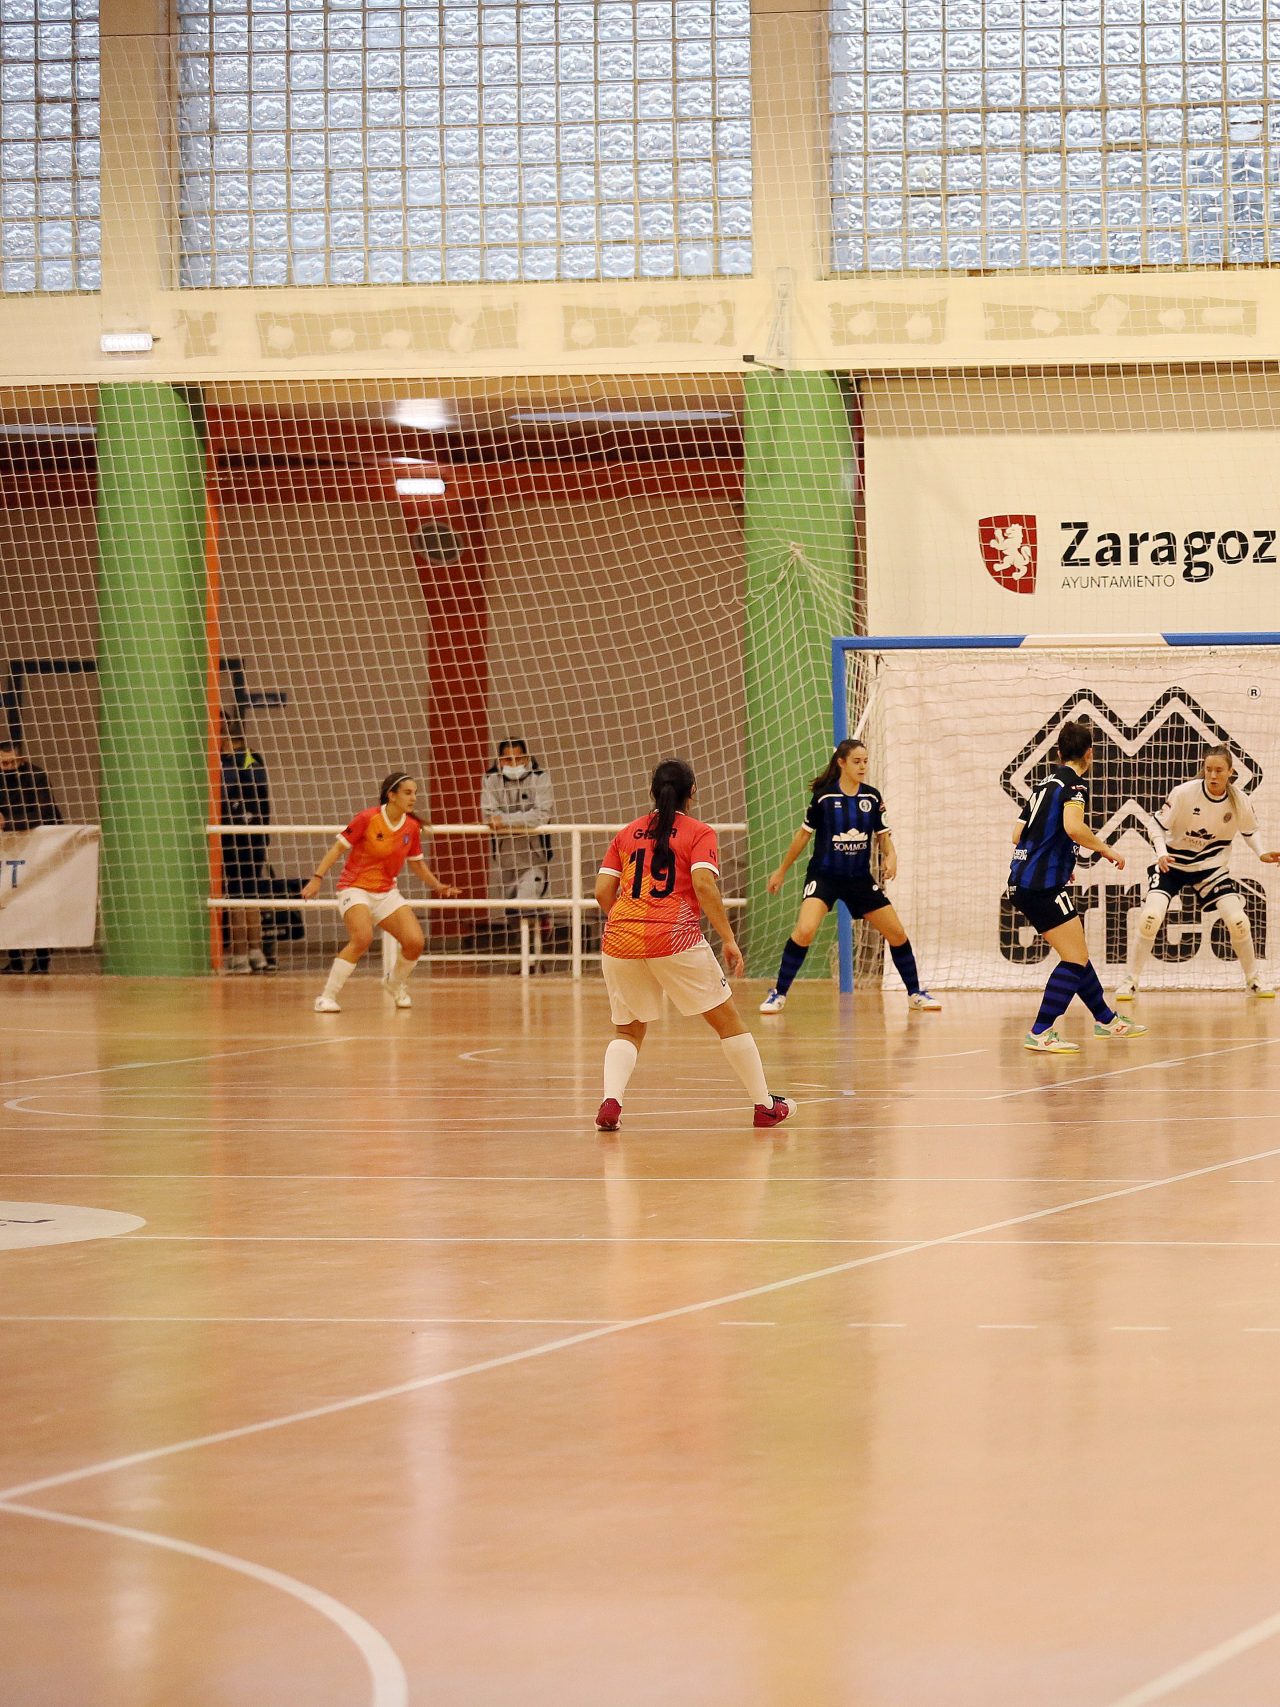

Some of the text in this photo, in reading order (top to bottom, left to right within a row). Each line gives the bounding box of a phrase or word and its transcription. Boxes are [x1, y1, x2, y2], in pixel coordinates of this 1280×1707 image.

[1061, 575, 1175, 590] AYUNTAMIENTO
[633, 828, 678, 840] GISA
[833, 841, 868, 852] SOMMOS
[628, 848, 676, 899] 19
[803, 880, 817, 899] 10
[1054, 891, 1075, 916] 17
